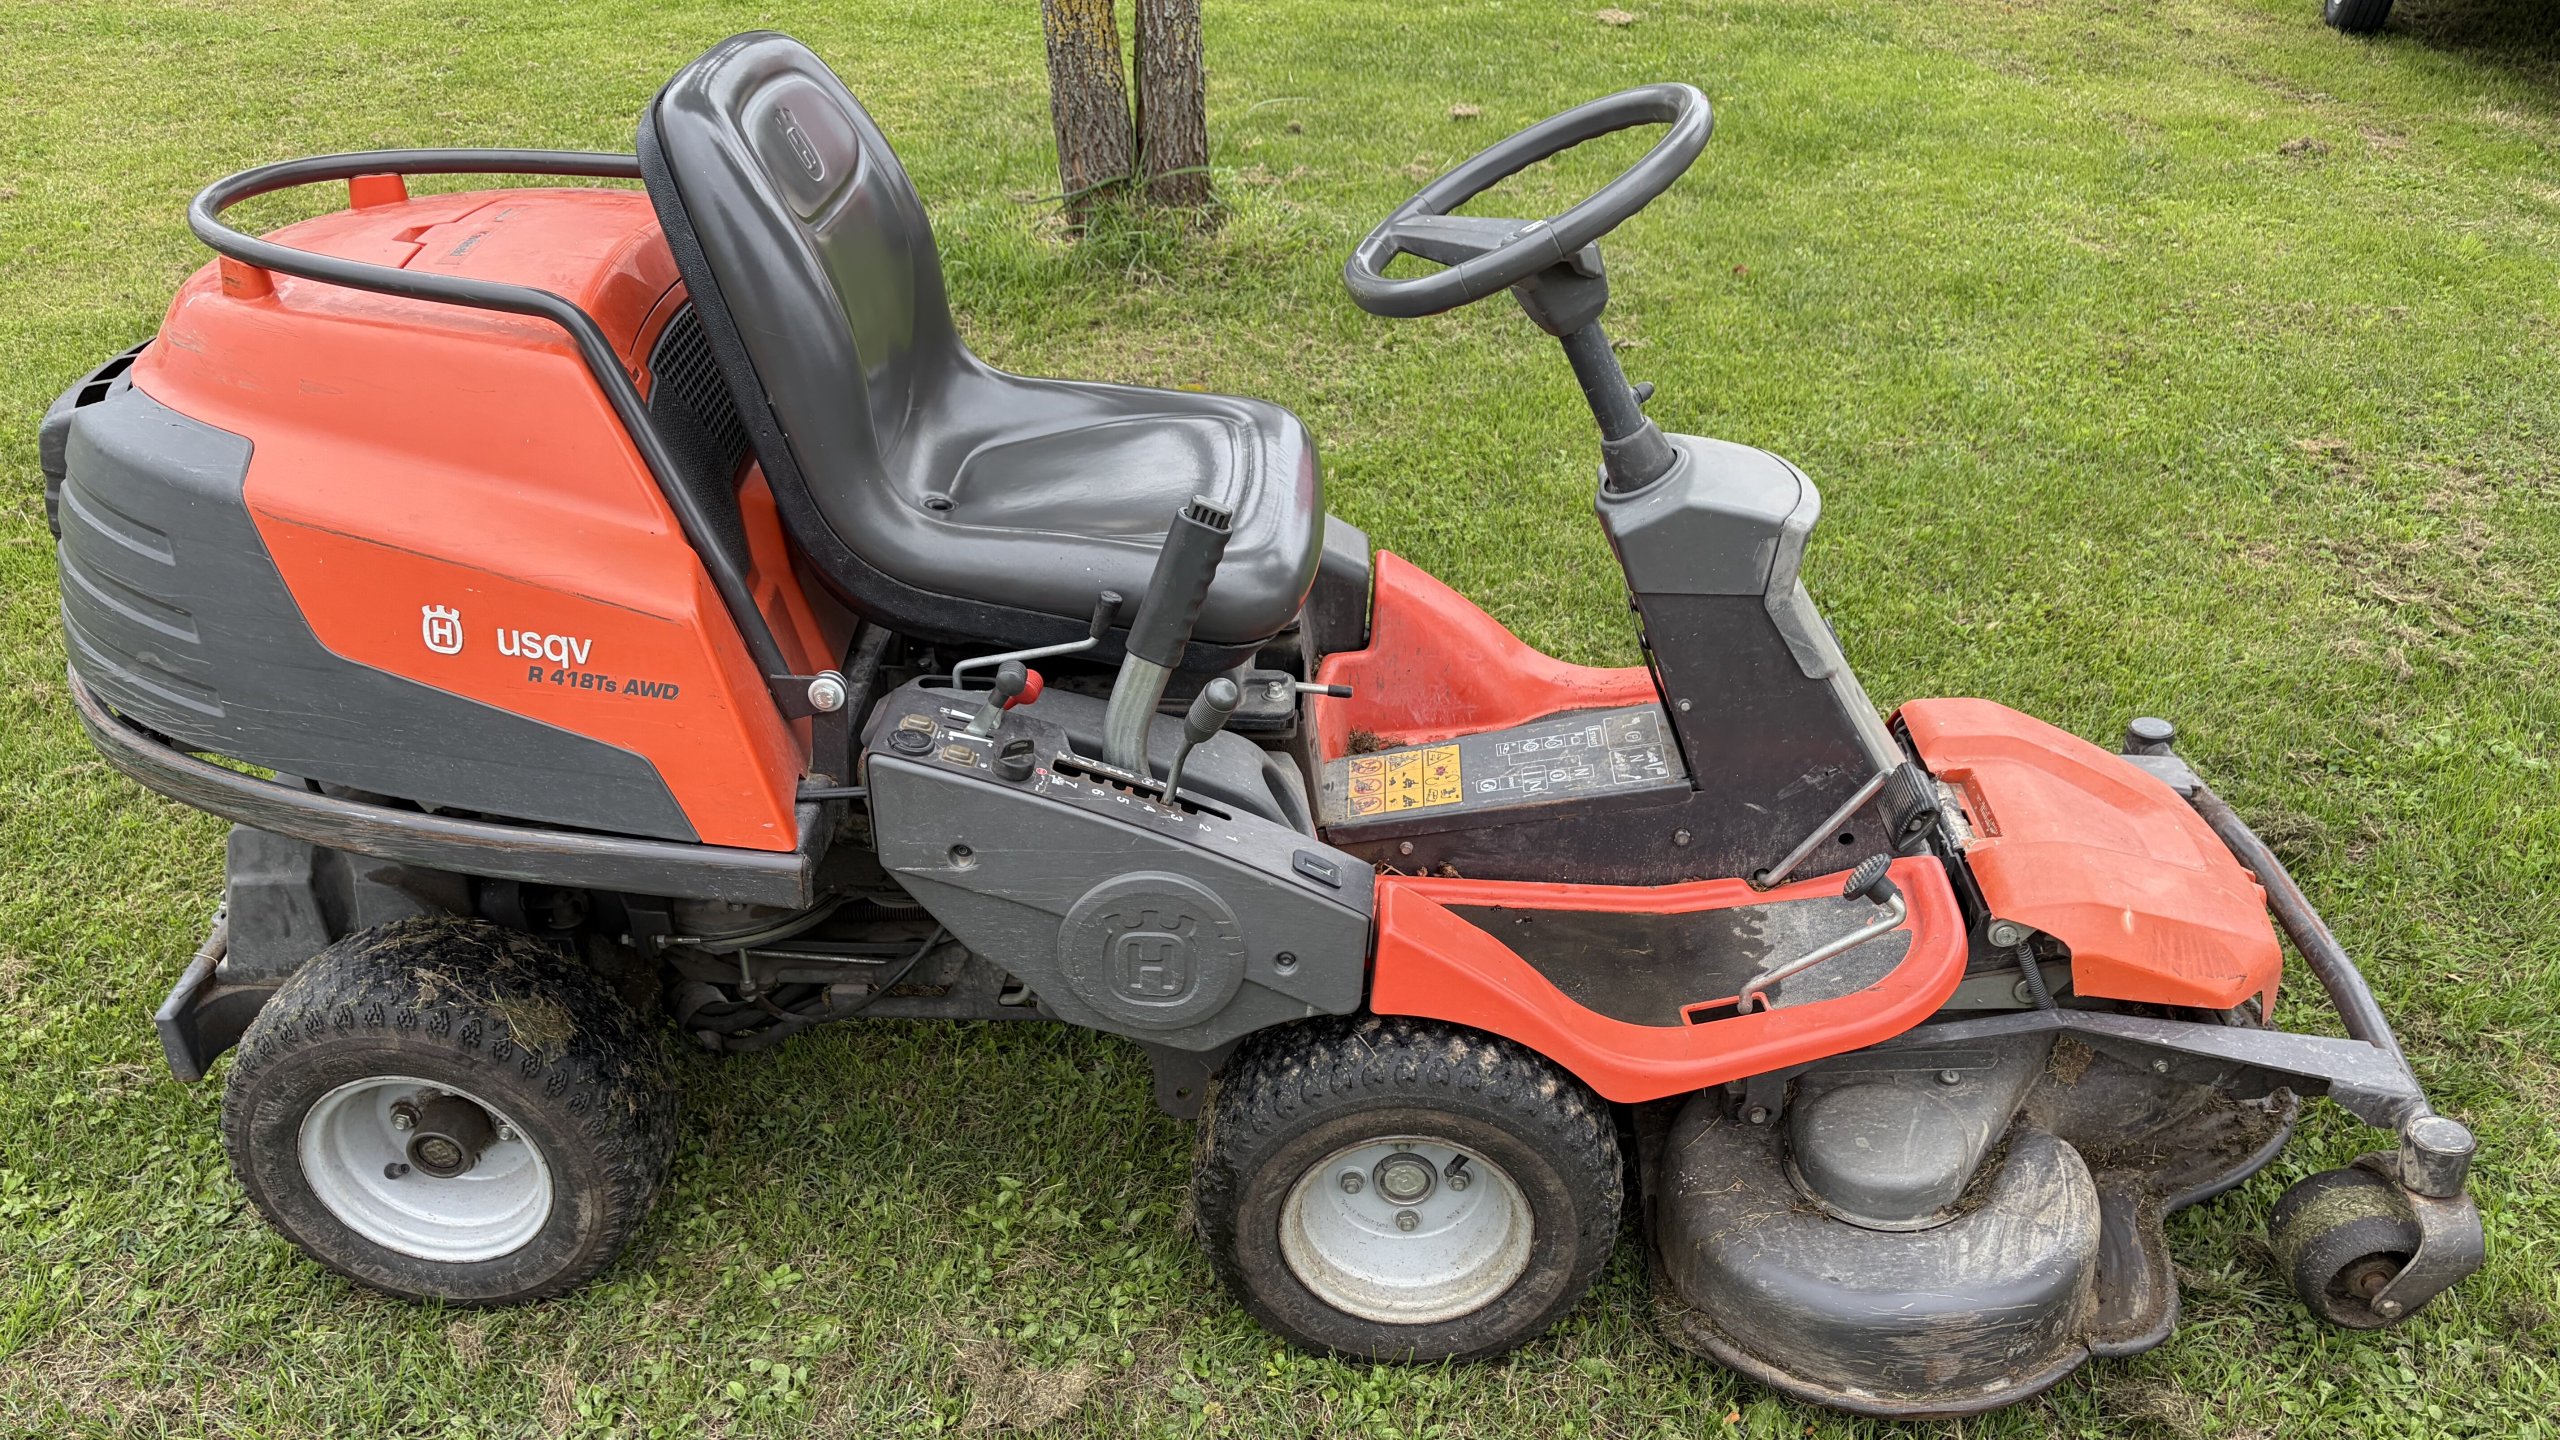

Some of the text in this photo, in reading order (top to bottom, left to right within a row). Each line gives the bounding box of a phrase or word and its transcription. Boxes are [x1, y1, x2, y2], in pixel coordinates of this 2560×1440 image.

[496, 628, 593, 669] usqv
[527, 665, 680, 701] R 418Ts AWD
[1065, 781, 1078, 789] 7
[1091, 788, 1105, 797] 6
[1116, 796, 1130, 805] 5
[1143, 805, 1157, 813] 4
[1170, 813, 1184, 822] 3
[1199, 823, 1212, 832] 2
